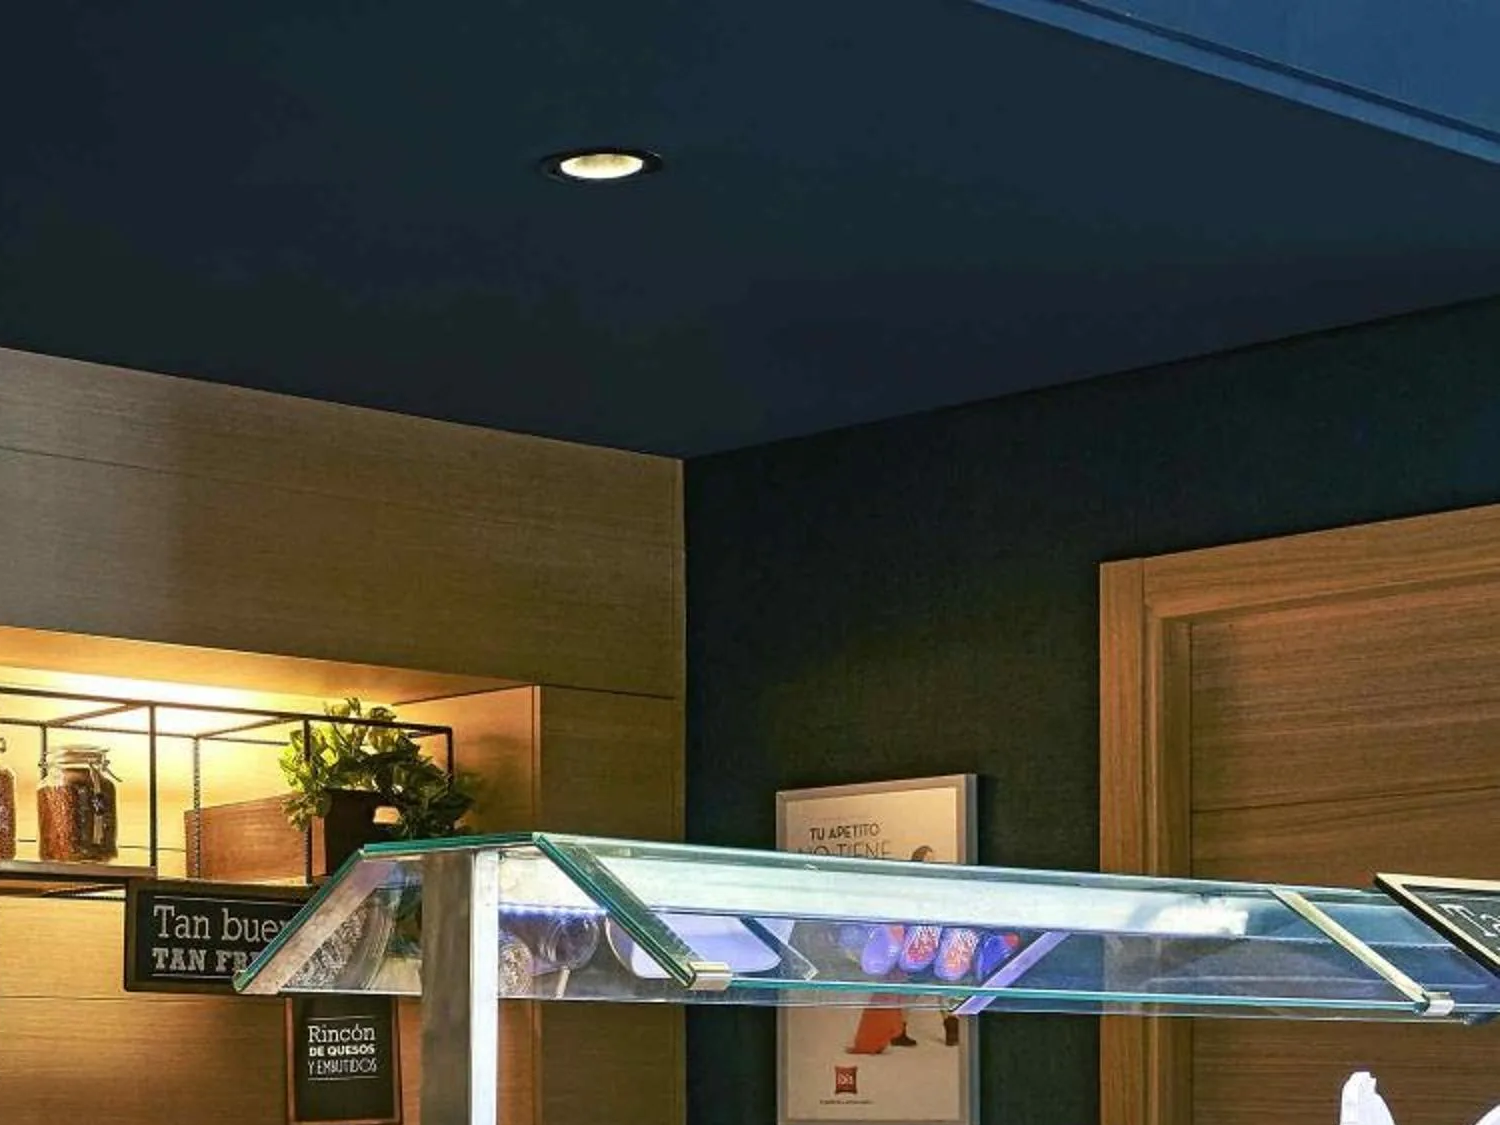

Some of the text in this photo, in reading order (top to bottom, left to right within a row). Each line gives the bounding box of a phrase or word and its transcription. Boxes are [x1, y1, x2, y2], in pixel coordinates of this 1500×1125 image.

[809, 823, 881, 841] TU APETITO
[153, 904, 286, 943] Tan bue
[152, 947, 206, 972] TAN
[307, 1023, 376, 1043] Rincón
[309, 1044, 375, 1057] DE QUESOS
[307, 1057, 377, 1076] Y EMBUTIDOS
